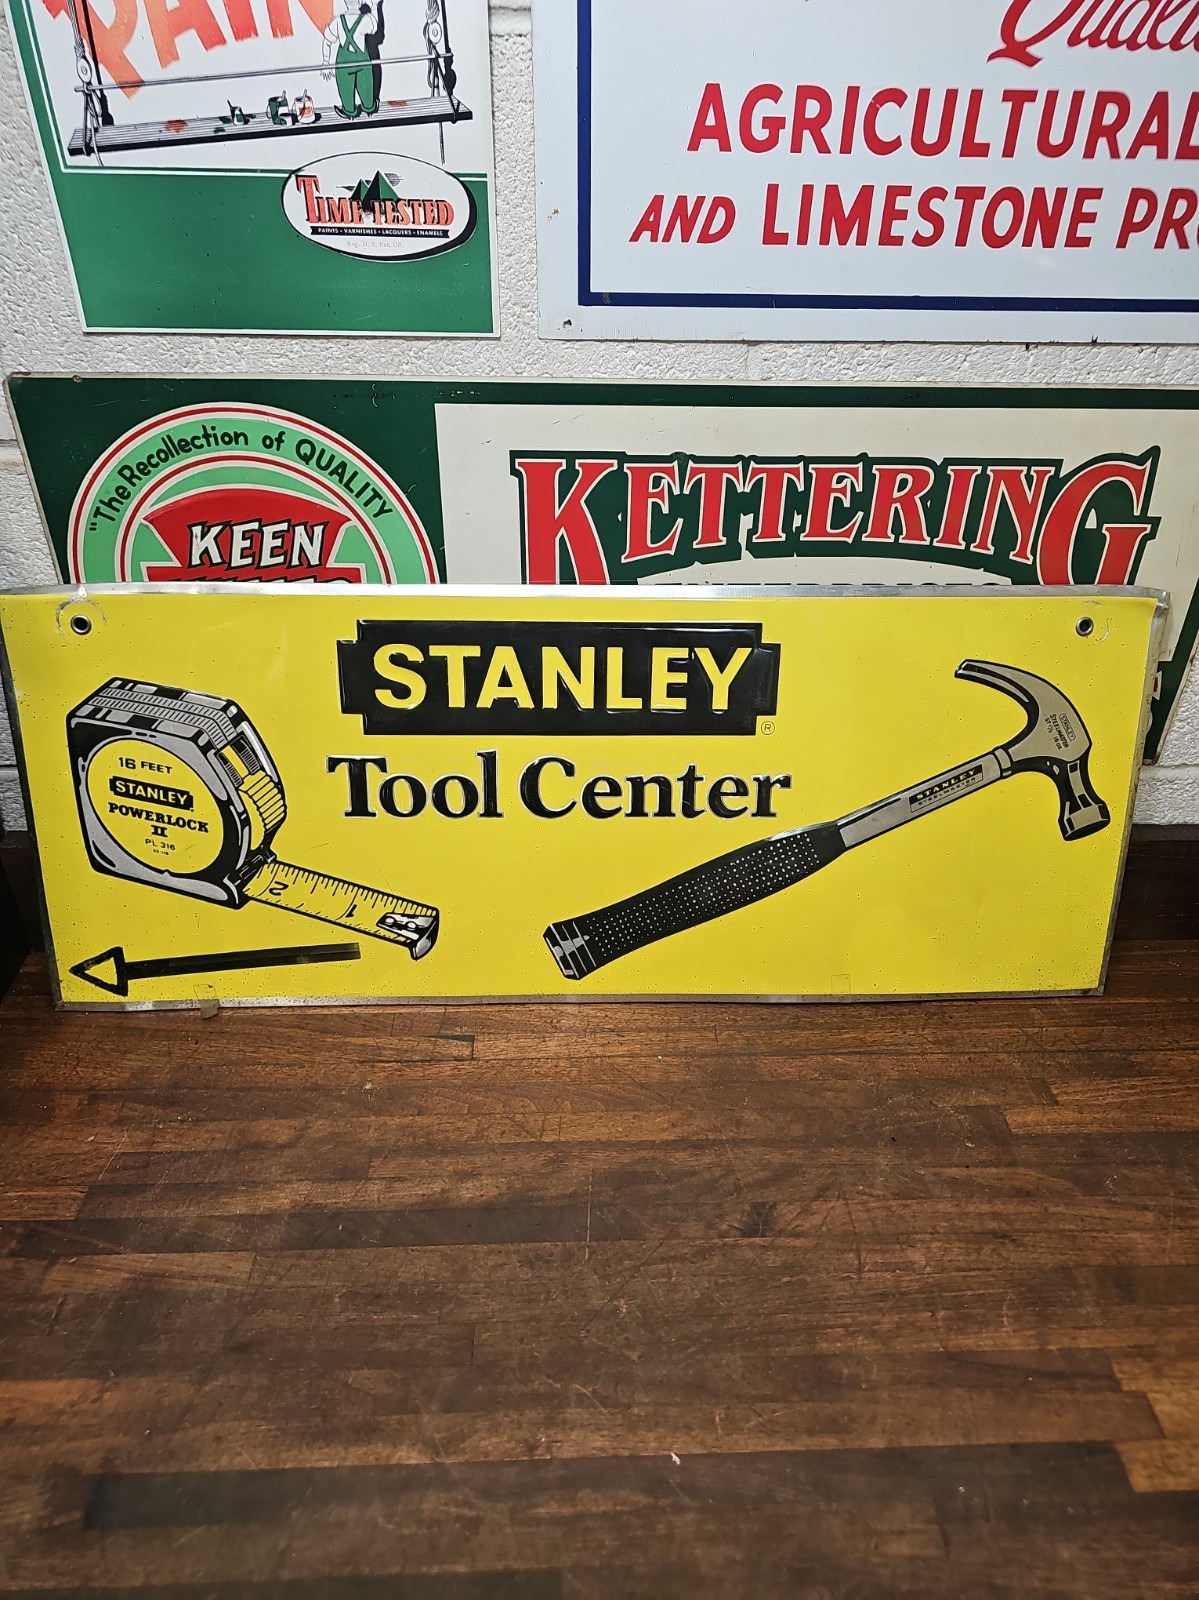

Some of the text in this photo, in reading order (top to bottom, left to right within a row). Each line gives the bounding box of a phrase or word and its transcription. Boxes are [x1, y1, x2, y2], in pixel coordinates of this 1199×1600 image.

[686, 82, 1199, 160] AGRICULTURAL
[317, 227, 443, 238] PAINTS VARNISHES LACQUERS ENAMELS
[629, 183, 1199, 250] AND LIMESTONE PR
[117, 424, 250, 488] Recollection
[261, 430, 287, 452] of
[294, 438, 394, 520] QUALITY
[512, 446, 1160, 585] KETTERING
[187, 517, 328, 571] KEEN
[373, 643, 753, 713] STANLEY
[118, 756, 174, 774] 16 FEET
[326, 748, 793, 819] Tool Center
[916, 769, 976, 800] STANLEY
[115, 780, 188, 806] STANLEY
[107, 801, 210, 834] POWERLOCK
[150, 824, 169, 838] II
[144, 838, 177, 852] PL 316
